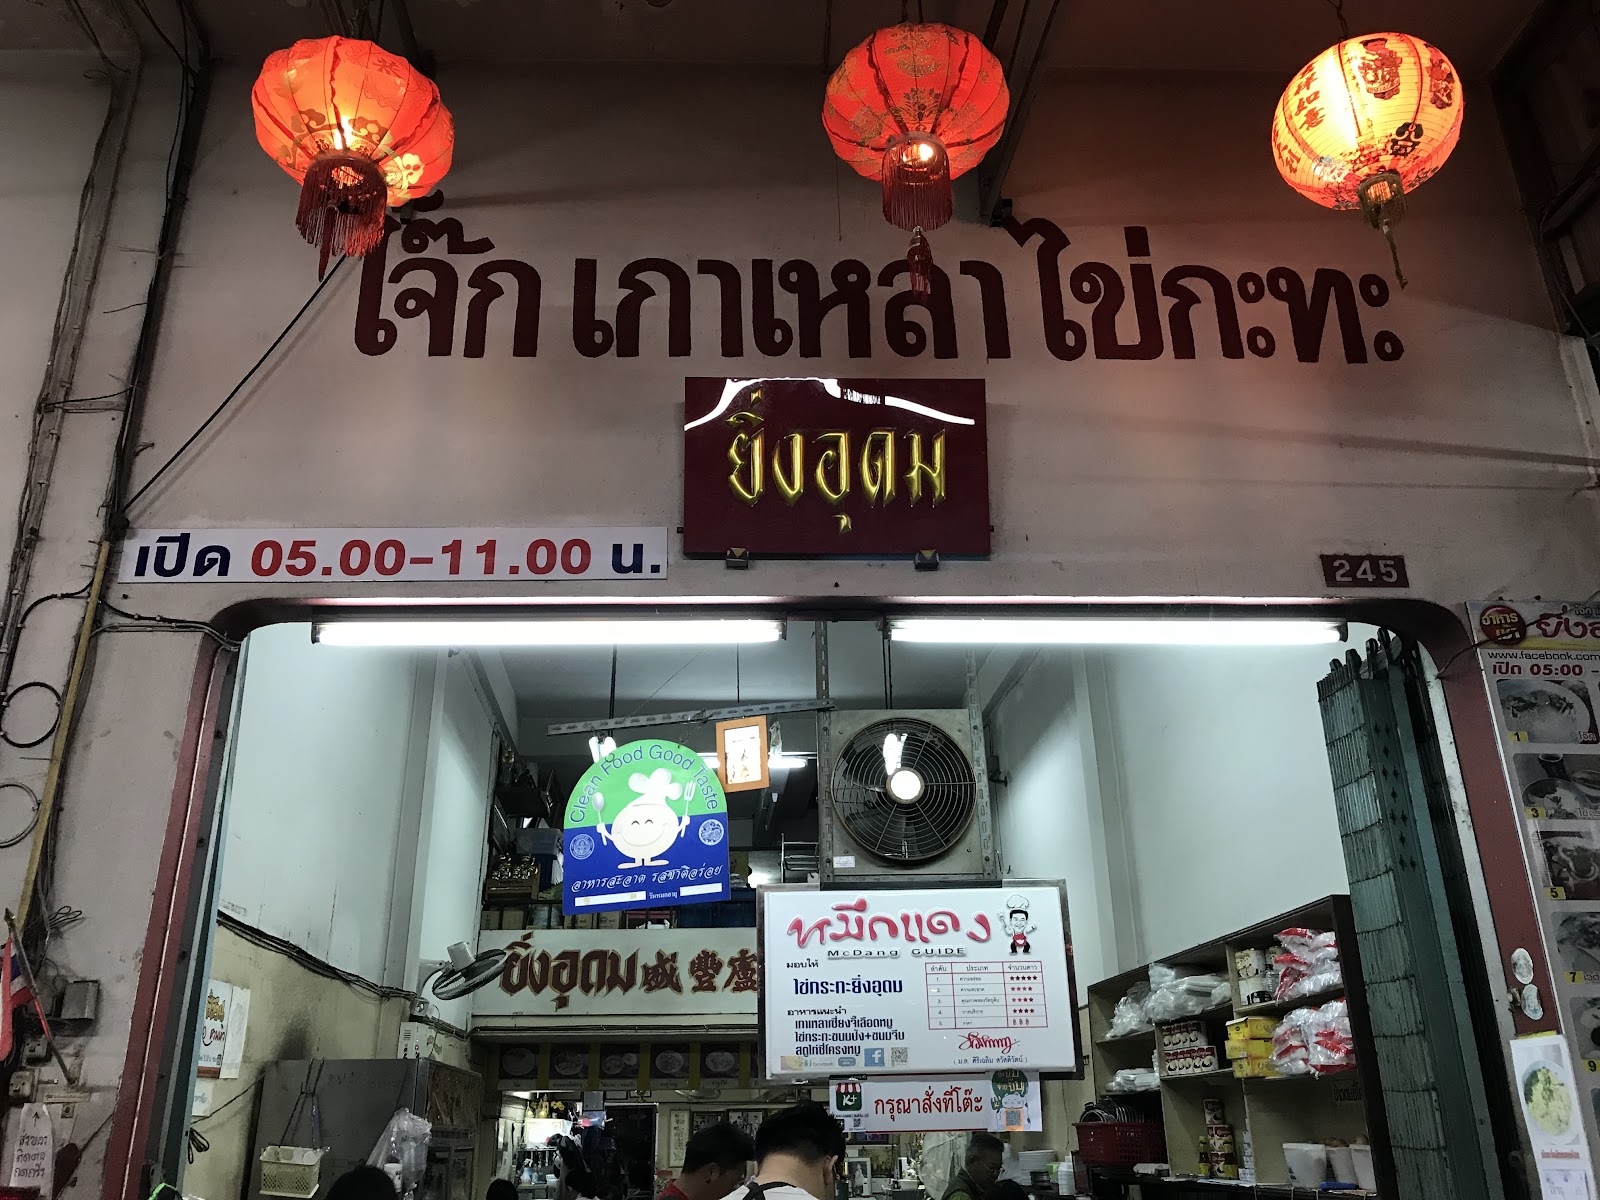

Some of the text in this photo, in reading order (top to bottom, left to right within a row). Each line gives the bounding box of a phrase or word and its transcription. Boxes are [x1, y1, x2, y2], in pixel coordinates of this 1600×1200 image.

[573, 258, 1011, 358] เกาเหลา
[1003, 216, 1404, 364] ไข่กะทะ
[728, 386, 946, 533] ยิ่งอุดม
[134, 532, 661, 577] เปิด 05.00-11.00 น.
[1333, 559, 1398, 582] 245
[1482, 612, 1519, 626] อาหาร
[1492, 661, 1522, 675] เปิด
[1530, 663, 1584, 676] 05:00
[1513, 731, 1521, 742] 1
[569, 744, 718, 823] Clean Food Good Taste
[1531, 807, 1540, 818] 3
[571, 863, 724, 893] อาหารสะอาด รสชาติอร่อย
[1550, 887, 1559, 899] 5
[787, 898, 991, 948] หมึกแดง
[828, 947, 966, 958] McDang GUIDE
[786, 957, 819, 968] มอบให้
[1008, 963, 1037, 971] จำนวนดาว
[499, 931, 638, 1011] ยิ่งอุดม
[1569, 972, 1578, 983] 7
[793, 974, 903, 997] ไข่กระทะยิ่งอุดม
[787, 1006, 847, 1016] อาหารแนะนำ
[1588, 1060, 1597, 1072] 9
[874, 1085, 983, 1121] กรุณาสั่งที่โต๊ะ
